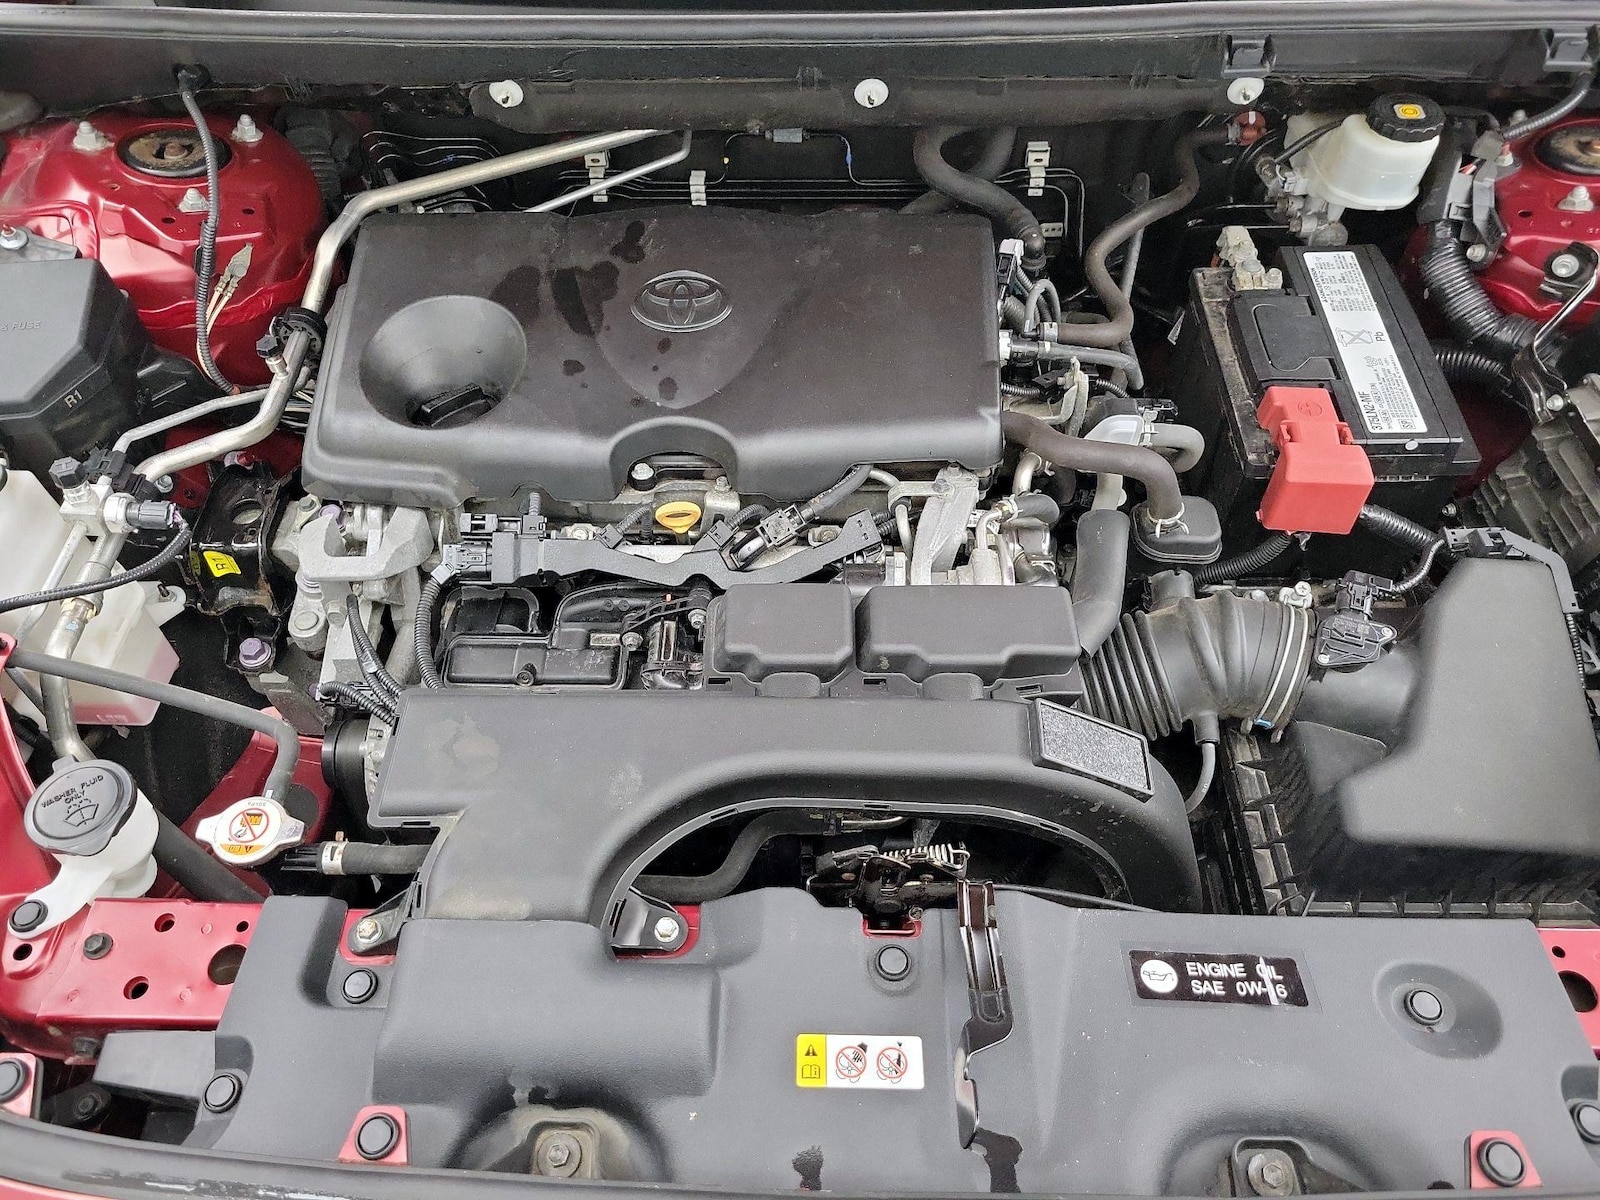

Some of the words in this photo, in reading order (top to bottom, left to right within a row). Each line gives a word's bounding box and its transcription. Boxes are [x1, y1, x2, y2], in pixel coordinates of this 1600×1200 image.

[11, 320, 41, 331] FUSE
[1374, 331, 1387, 342] Pb
[64, 389, 83, 408] R1
[41, 787, 77, 808] WASHER
[81, 774, 104, 790] FLUID
[64, 790, 86, 804] ONLY
[1185, 961, 1247, 978] ENGINE
[1256, 963, 1284, 980] OIL
[1190, 979, 1226, 996] SAE
[1235, 980, 1288, 999] 0W-6
